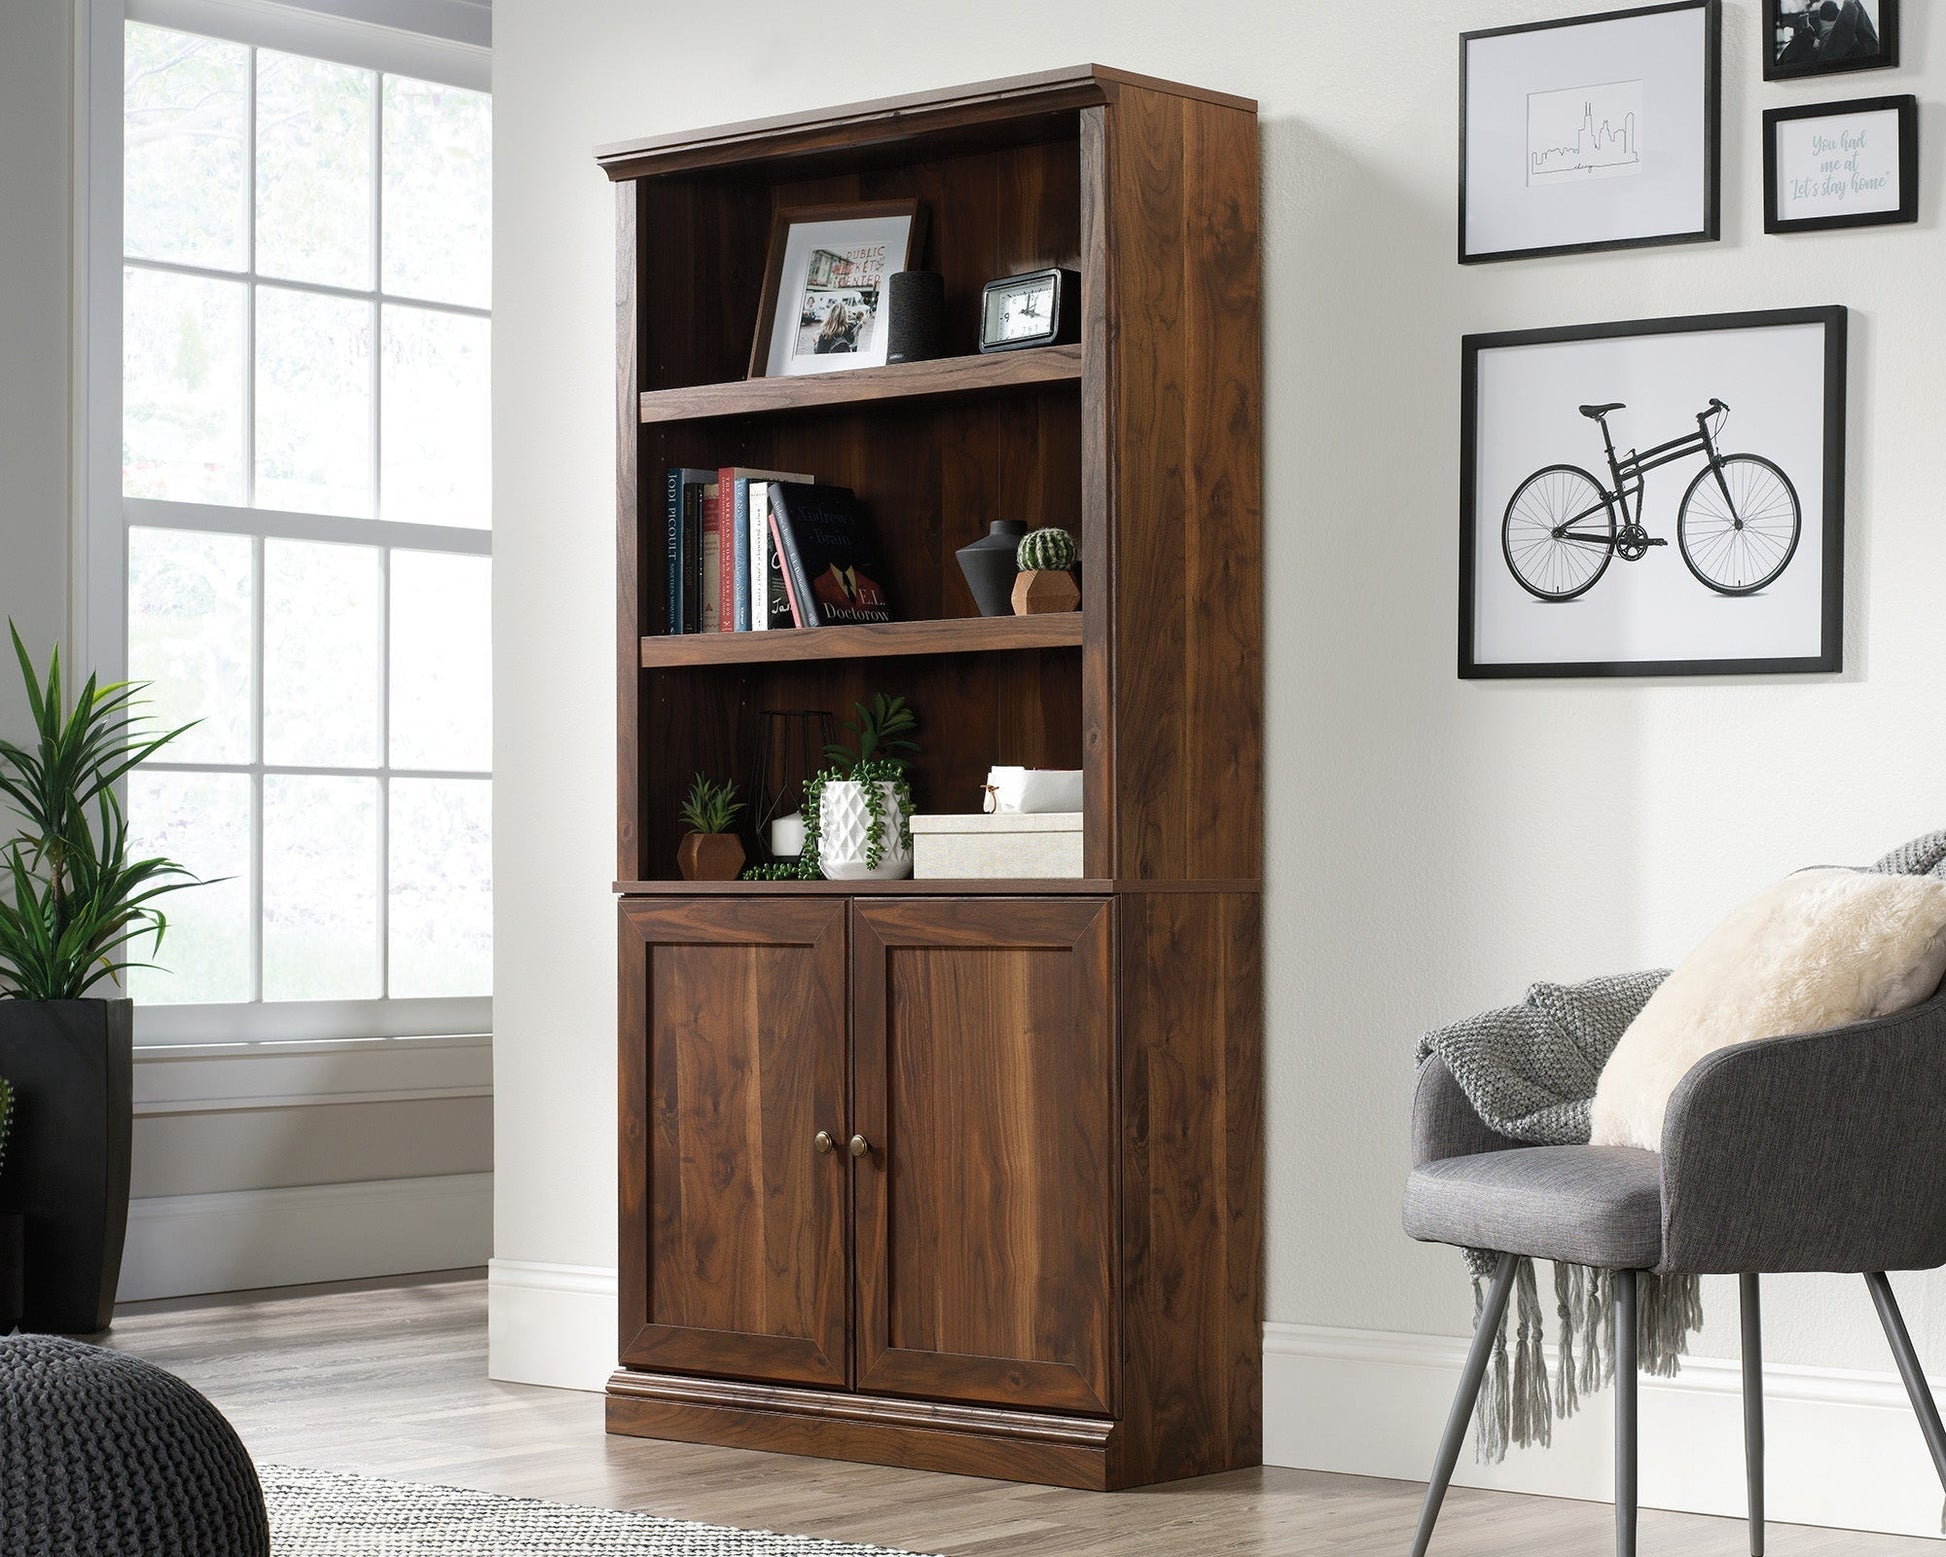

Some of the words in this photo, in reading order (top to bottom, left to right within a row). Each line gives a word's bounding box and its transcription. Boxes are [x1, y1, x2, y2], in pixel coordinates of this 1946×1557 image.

[1811, 135, 1838, 156] You
[1840, 128, 1867, 151] had
[1820, 159, 1841, 173] me
[1844, 150, 1860, 172] at
[1821, 175, 1848, 200] stay
[846, 245, 885, 260] PUBLIC
[1003, 312, 1010, 323] 9
[667, 474, 678, 502] JODI
[667, 507, 677, 561] PICOULT
[858, 588, 887, 606] E.L.
[822, 602, 890, 622] Doctorow
